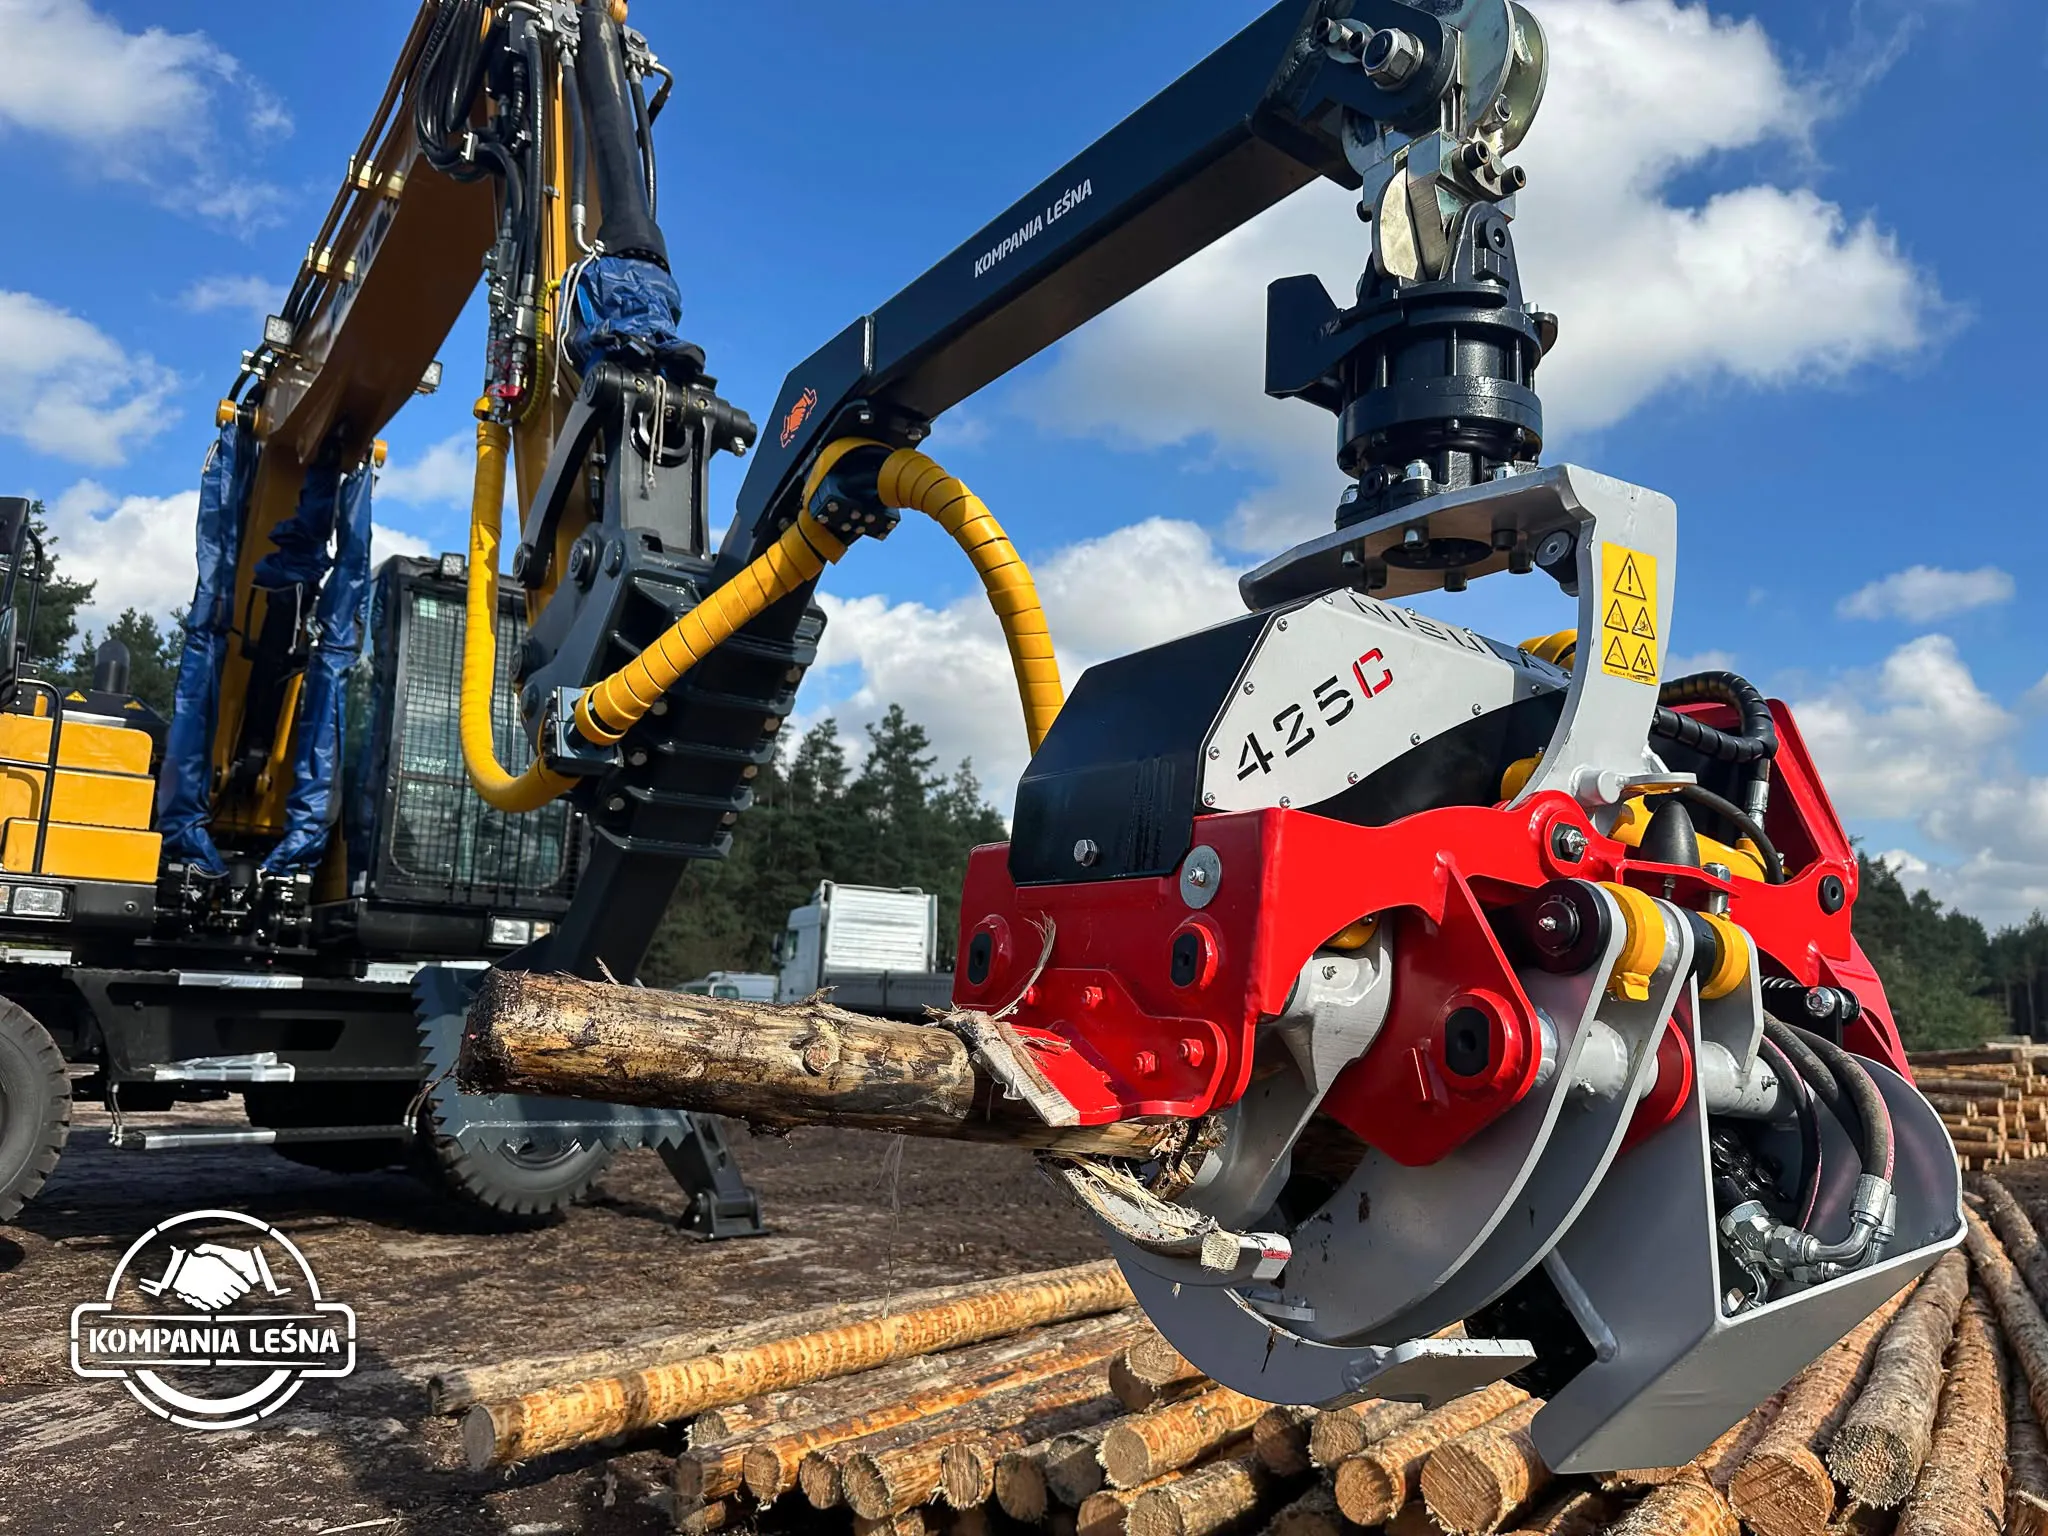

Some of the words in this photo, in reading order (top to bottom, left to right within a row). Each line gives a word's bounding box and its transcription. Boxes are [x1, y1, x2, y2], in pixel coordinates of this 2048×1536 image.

[974, 215, 1043, 278] KOMPANIA
[1046, 178, 1093, 225] LEŚNA
[1237, 647, 1393, 781] 425C
